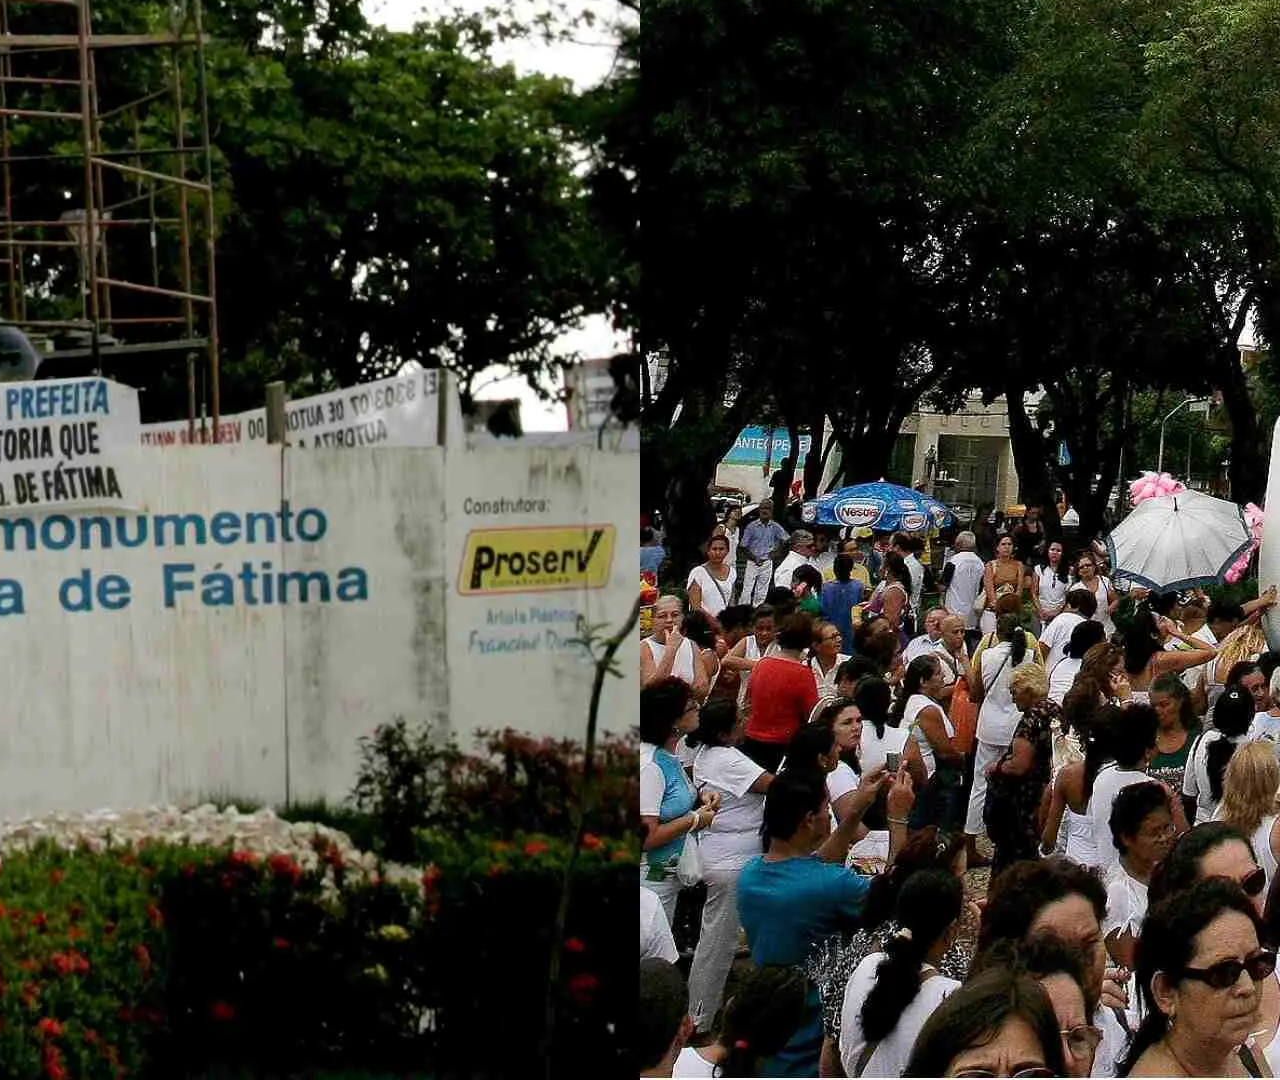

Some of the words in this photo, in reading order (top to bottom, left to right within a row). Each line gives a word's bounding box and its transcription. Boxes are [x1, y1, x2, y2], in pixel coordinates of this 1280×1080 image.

[6, 379, 110, 420] PREFEITA
[59, 422, 100, 461] QUE
[13, 472, 39, 505] DE
[42, 461, 123, 502] FÁTIMA
[470, 529, 604, 590] Proserv
[58, 568, 131, 613] de
[162, 560, 369, 609] Fátima
